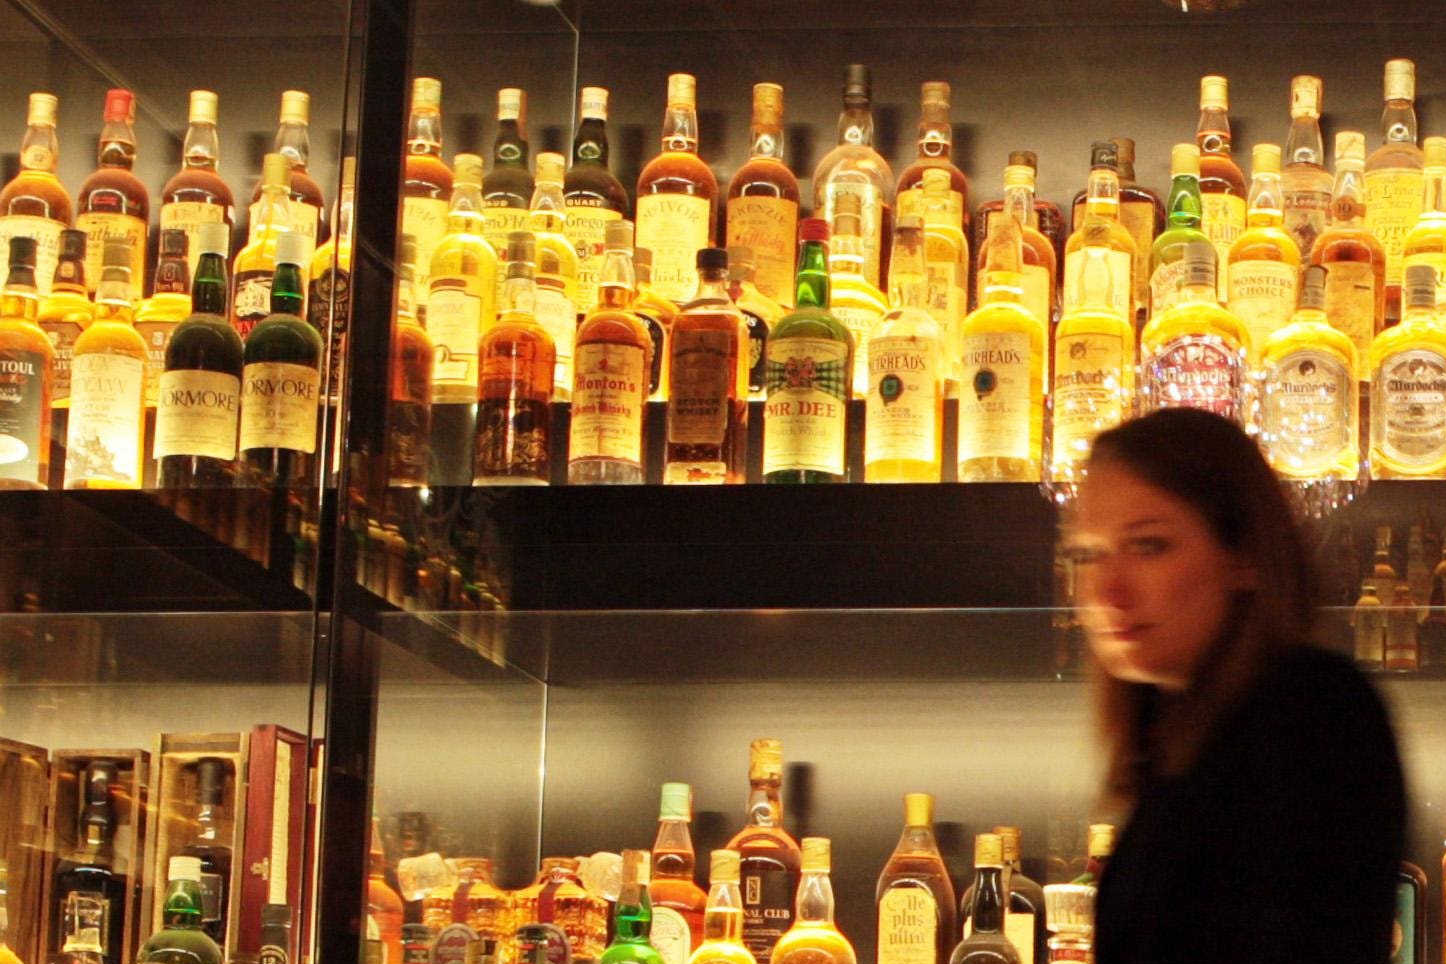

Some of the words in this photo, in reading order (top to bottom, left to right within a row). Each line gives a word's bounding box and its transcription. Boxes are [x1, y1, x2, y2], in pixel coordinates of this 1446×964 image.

[566, 212, 604, 230] Grego
[798, 401, 837, 418] DEE
[763, 908, 791, 919] CLUB
